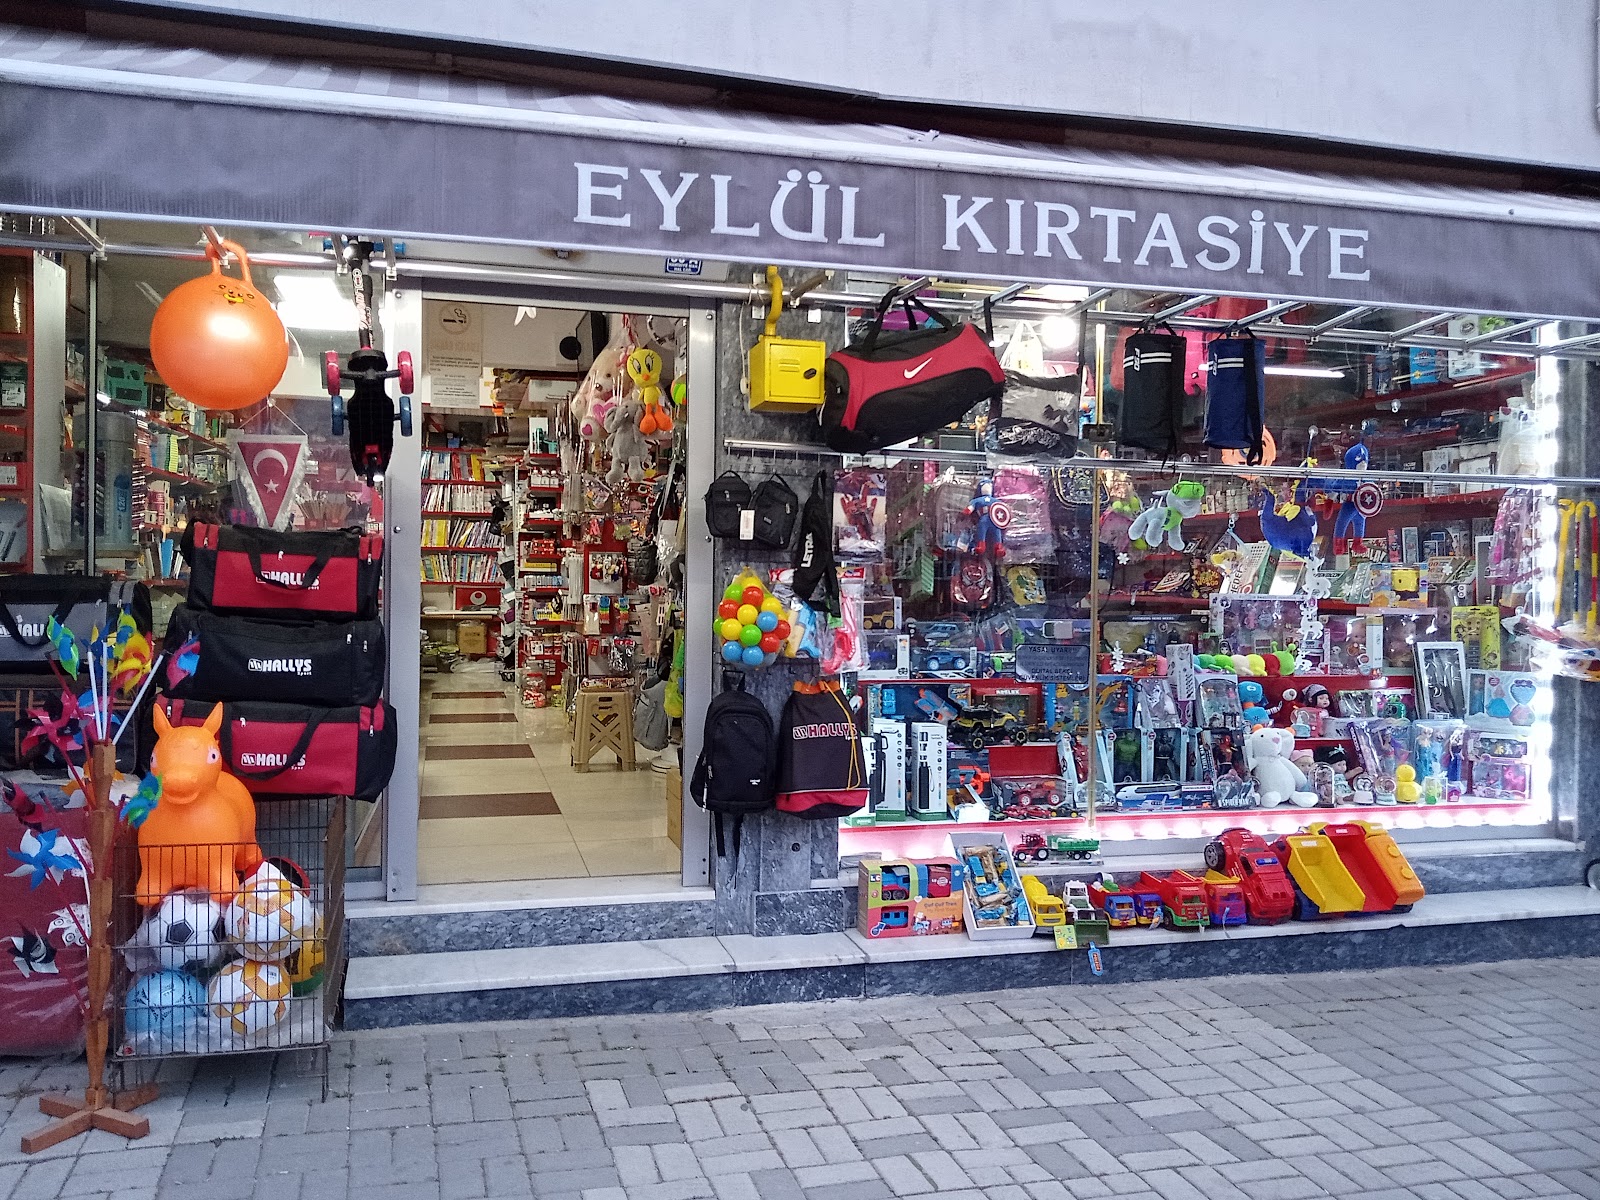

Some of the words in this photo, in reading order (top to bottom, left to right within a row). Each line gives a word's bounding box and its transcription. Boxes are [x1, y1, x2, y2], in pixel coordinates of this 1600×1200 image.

[573, 161, 886, 248] EYLÜL
[941, 193, 1372, 283] KIRTASİYE
[800, 531, 814, 568] LETRA
[262, 658, 312, 673] HALLYS
[807, 722, 858, 738] HALLYS
